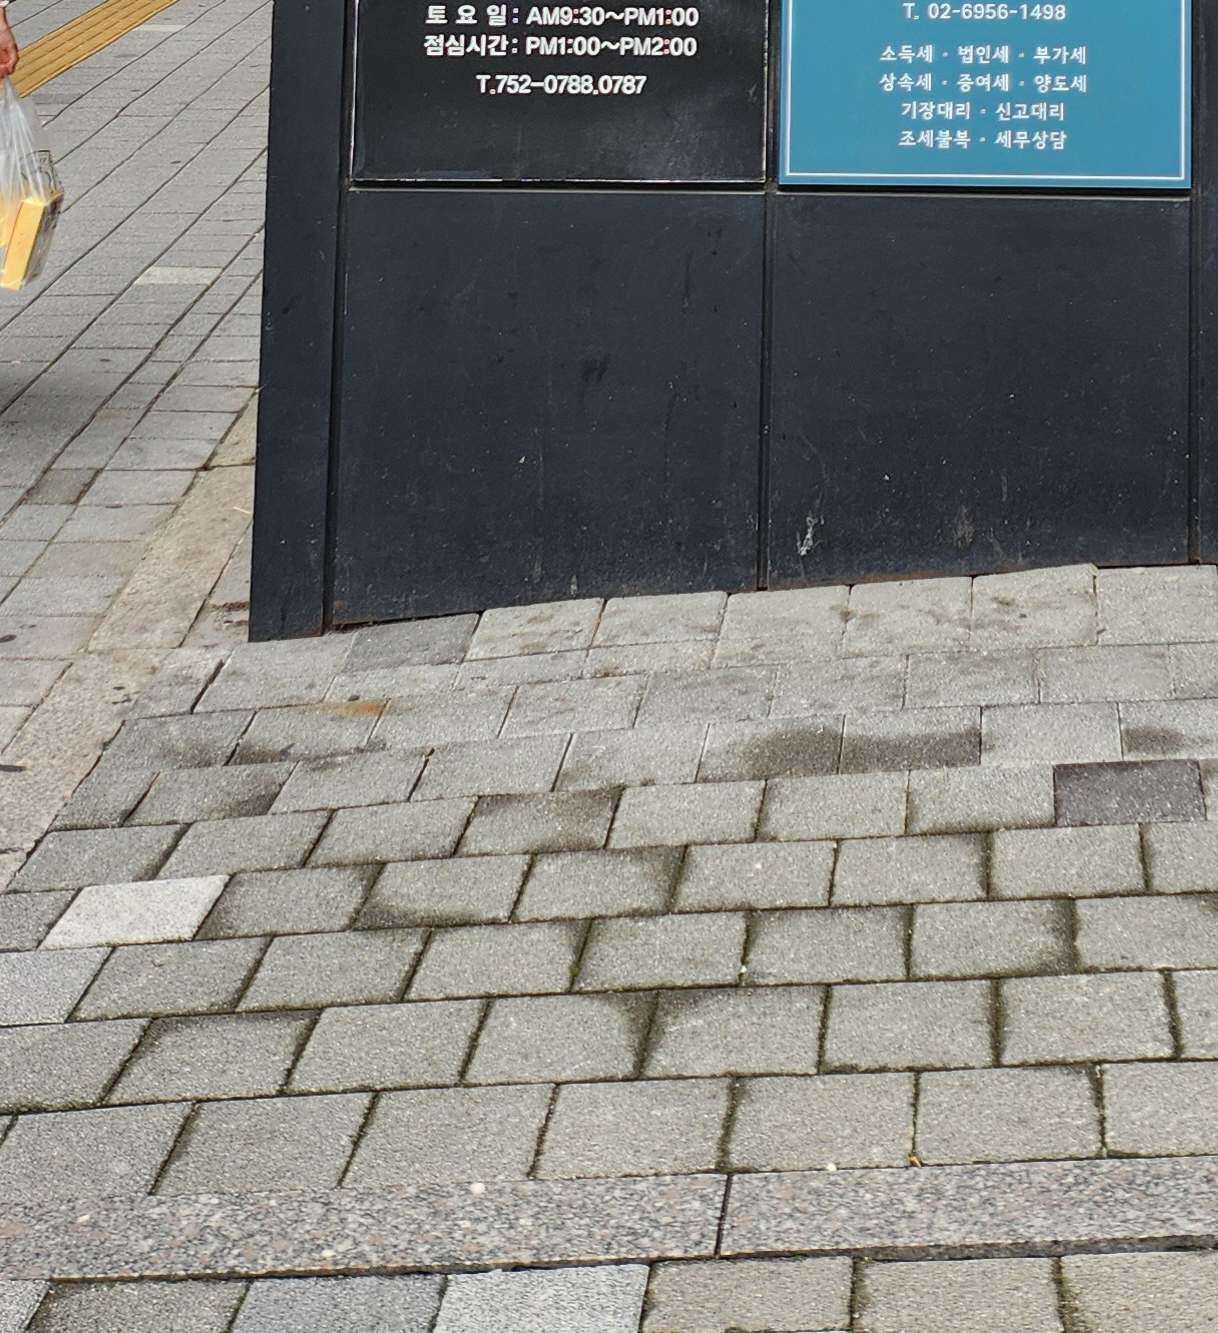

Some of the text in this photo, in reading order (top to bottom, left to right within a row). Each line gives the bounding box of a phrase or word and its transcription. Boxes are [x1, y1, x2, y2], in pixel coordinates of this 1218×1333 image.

[525, 6, 699, 27] AM9:30~PM1:00
[902, 2, 1066, 21] T. 02-6956-1498
[423, 33, 697, 57] 점심시간: PM1:00~PM2:00
[879, 44, 1086, 65] 소득세 법인세 부가세
[475, 74, 647, 95] T.752-0788.0787
[879, 72, 1087, 94] 상속세 증여세 양도세
[901, 100, 1064, 121] 기장대리 신고대리
[898, 129, 1068, 150] 조세불복 세무상담
